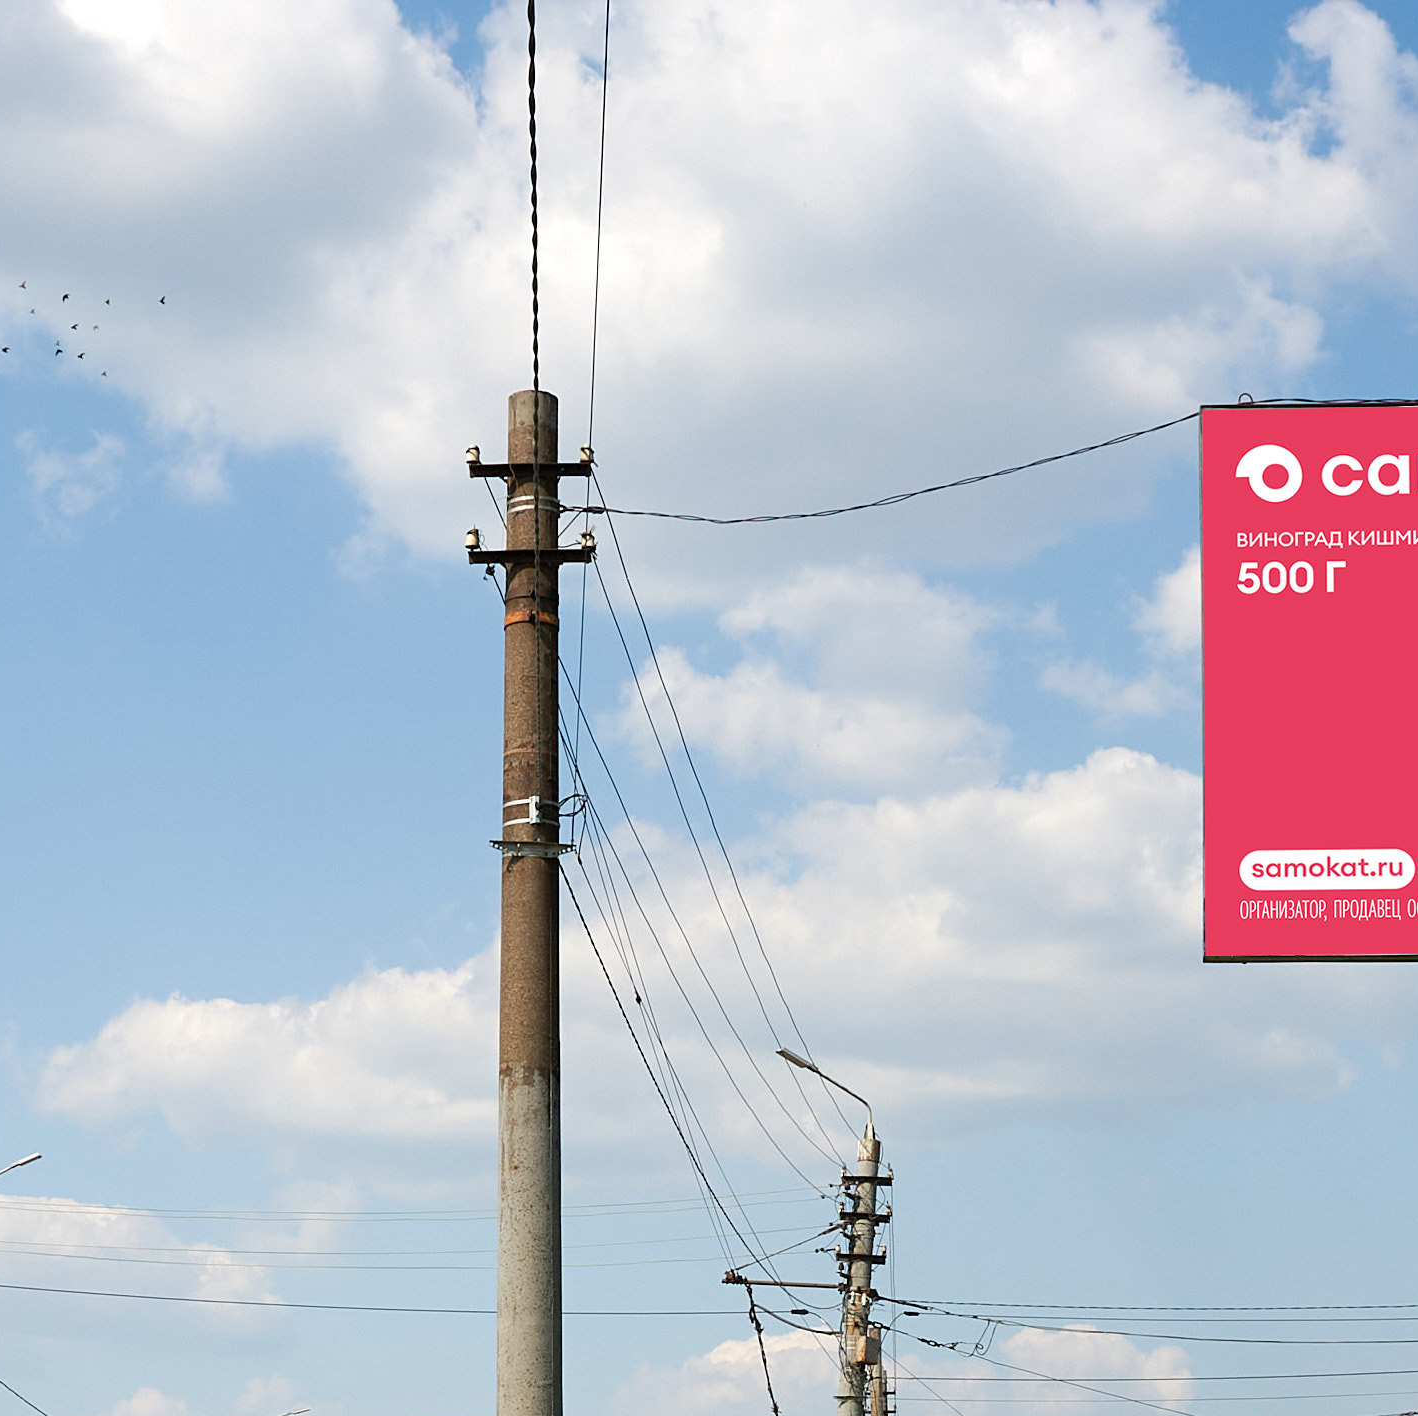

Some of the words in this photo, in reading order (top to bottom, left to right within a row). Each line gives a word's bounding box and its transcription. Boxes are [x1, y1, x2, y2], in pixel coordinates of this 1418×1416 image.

[1236, 530, 1344, 549] ВИНОГРАД
[1236, 560, 1315, 595] 500
[1326, 560, 1348, 593] Г
[1251, 855, 1404, 879] samokat.ru
[1239, 899, 1328, 922] ОРГАНИЗАТОР,
[1333, 898, 1402, 922] ПРОДАВЕЦ
